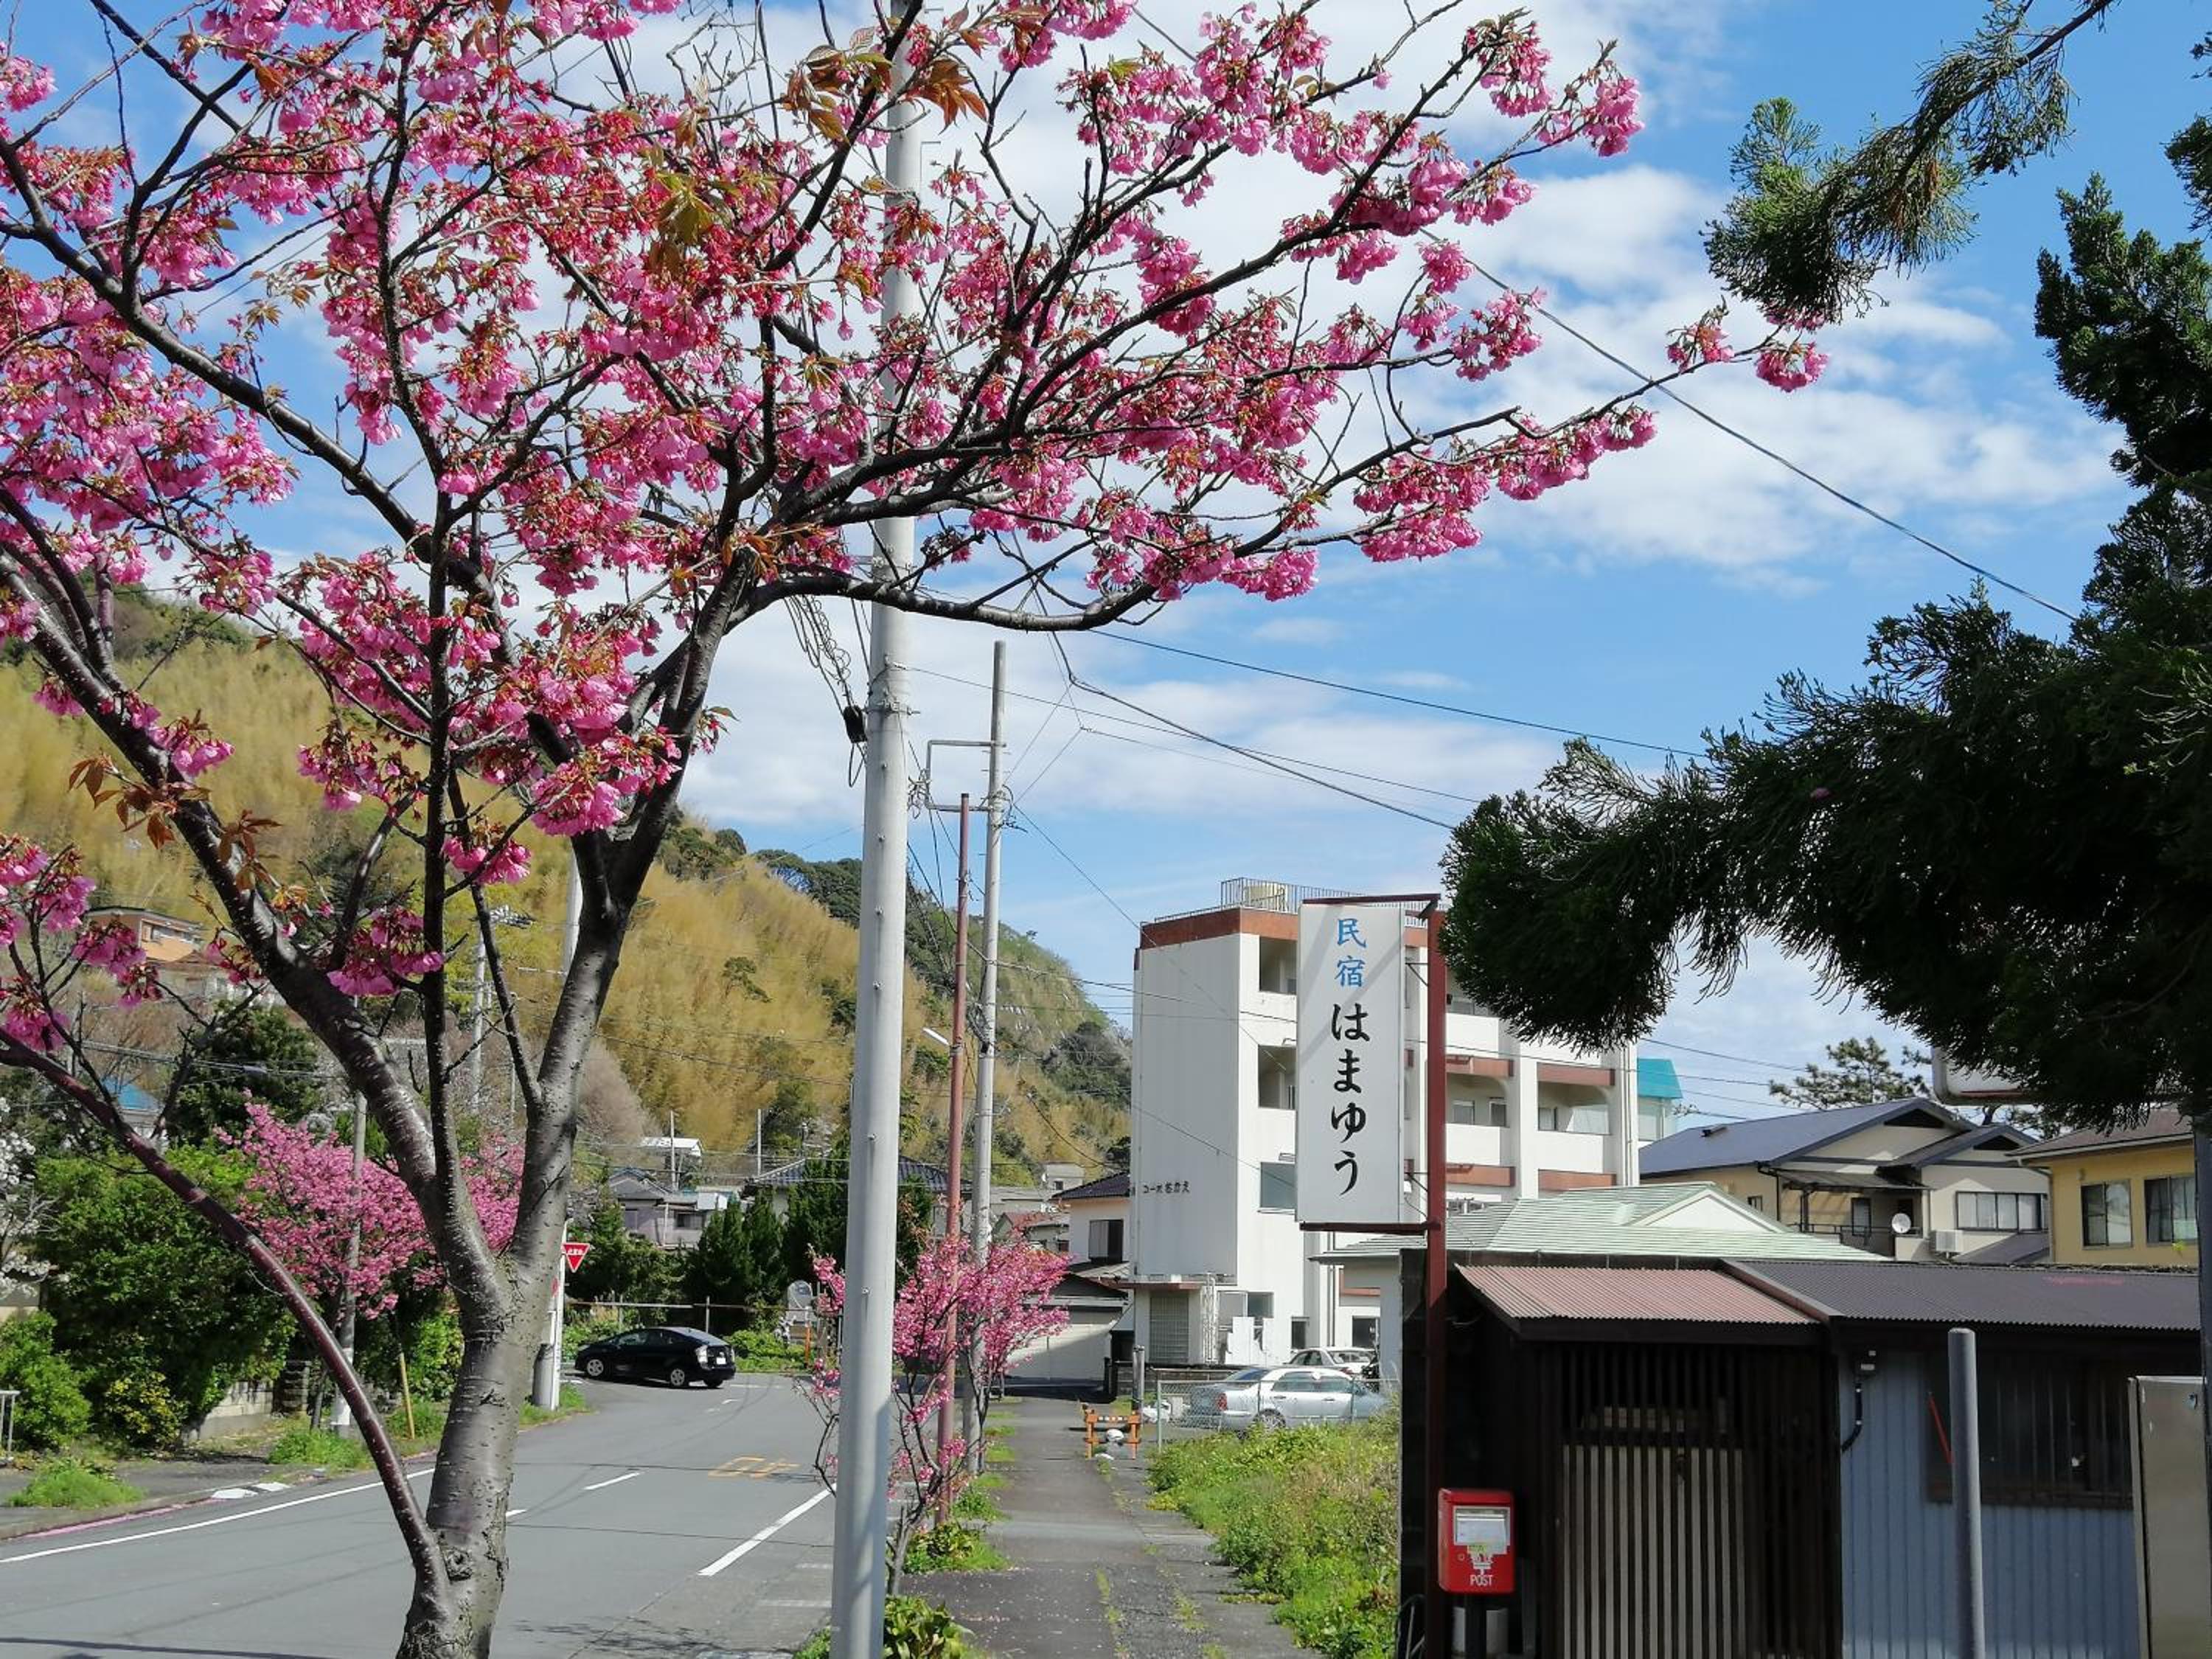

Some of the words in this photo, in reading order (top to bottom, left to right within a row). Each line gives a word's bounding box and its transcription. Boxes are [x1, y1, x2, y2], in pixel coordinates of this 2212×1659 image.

[1335, 917, 1367, 988] 民宿
[1330, 1003, 1370, 1196] はまゆう
[1470, 1574, 1494, 1586] POST
